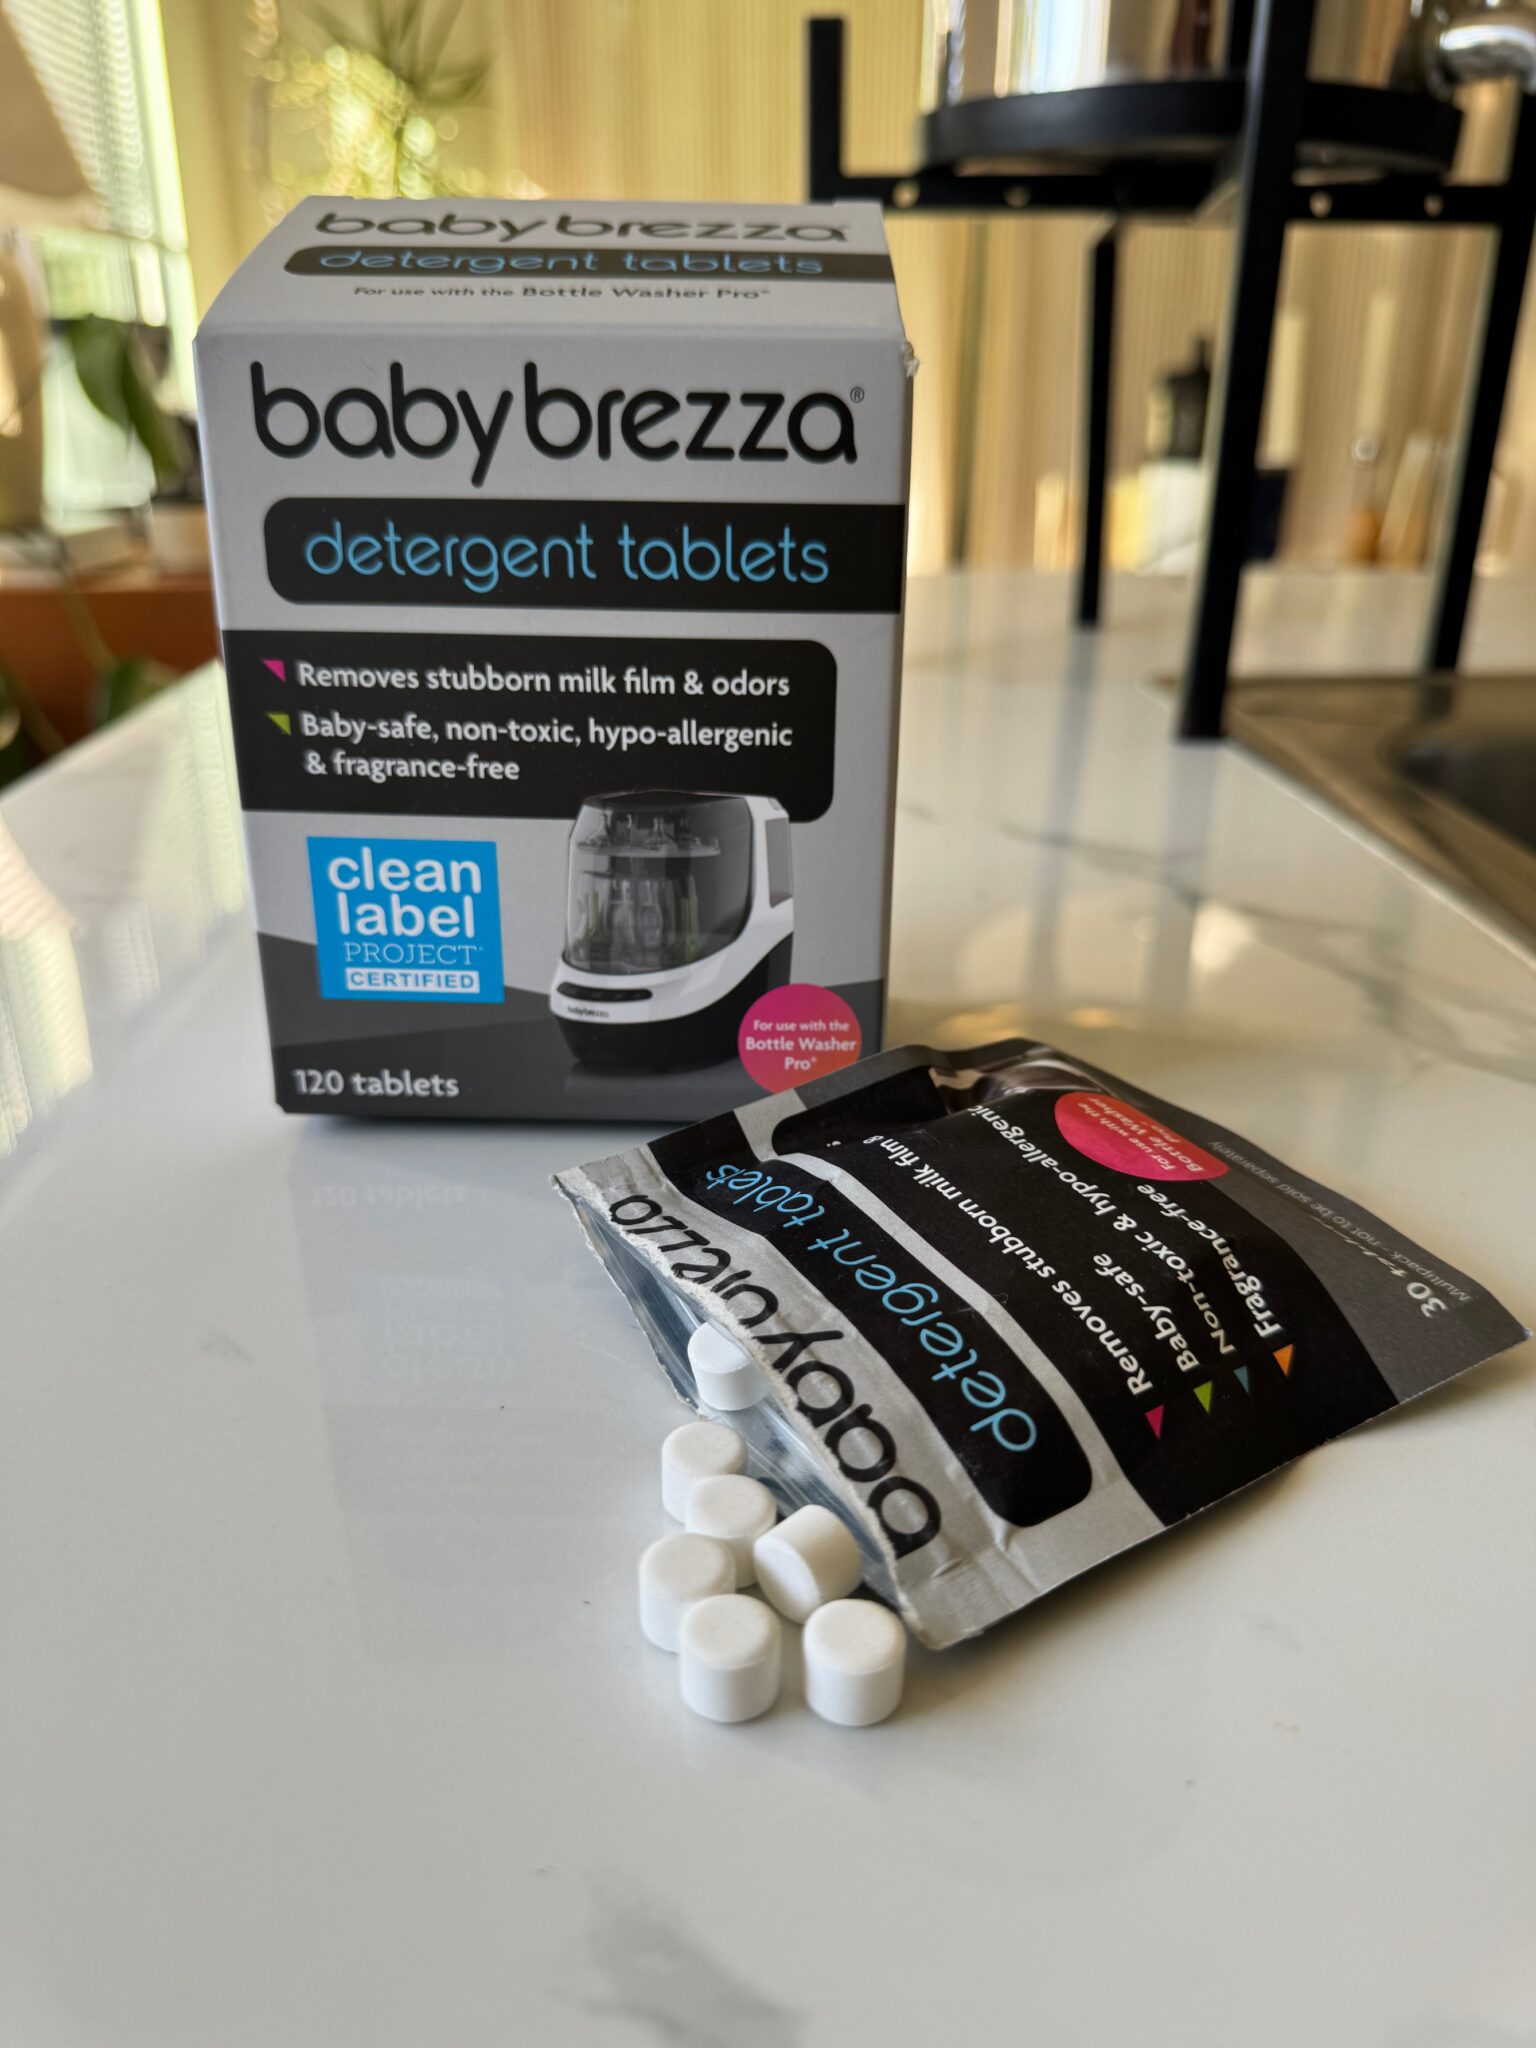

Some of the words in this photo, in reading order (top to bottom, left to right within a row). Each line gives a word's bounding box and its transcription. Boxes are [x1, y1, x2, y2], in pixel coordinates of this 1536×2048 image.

[319, 249, 598, 274] detergent
[623, 252, 823, 274] tablets
[354, 287, 384, 296] For
[392, 288, 424, 296] use
[431, 286, 474, 297] with
[481, 287, 514, 297] the
[522, 286, 602, 298] Bottle
[612, 287, 709, 299] Washer
[305, 519, 597, 593] detergent
[617, 523, 830, 584] tablets
[297, 660, 420, 690] Removes
[425, 662, 552, 692] stubborn
[558, 665, 617, 694] milk
[623, 666, 676, 695] film
[683, 669, 704, 695] &
[712, 668, 790, 696] odors
[300, 710, 440, 745] Baby-safe,
[446, 717, 582, 747] non-toxic,
[588, 716, 793, 754] hypo-allergenic
[304, 750, 327, 776] &
[332, 749, 521, 784] fragrance-free
[327, 846, 482, 894] clean
[336, 891, 475, 939] label
[350, 971, 475, 989] CERTIFIED
[753, 1019, 773, 1032] For
[776, 1021, 796, 1032] use
[799, 1019, 826, 1032] with
[829, 1019, 850, 1032] the
[745, 1036, 794, 1051] Bottle
[798, 1036, 857, 1052] Washer
[293, 1068, 345, 1096] 120
[350, 1068, 460, 1098] tablets
[1078, 1102, 1101, 1118] the
[1087, 1096, 1148, 1136] Washer
[1100, 1117, 1129, 1137] with
[880, 1138, 920, 1167] film
[968, 1104, 1117, 1216] hypo-allergenic
[1128, 1137, 1154, 1154] use
[1149, 1136, 1205, 1173] Bottle
[1150, 1154, 1178, 1171] For
[1208, 1140, 1280, 1184] separately
[705, 1164, 825, 1230] tablets
[913, 1163, 962, 1201] milk
[1277, 1184, 1312, 1203] sold
[1113, 1213, 1138, 1231] &
[1309, 1202, 1334, 1217] be
[1332, 1215, 1351, 1229] to
[958, 1198, 1056, 1278] stubborn
[1351, 1226, 1382, 1247] not
[1137, 1184, 1284, 1339] Fragrance-free
[1391, 1250, 1472, 1302] Multipack
[1135, 1231, 1236, 1356] Non-toxic
[1406, 1281, 1450, 1318] 30
[1093, 1253, 1201, 1372] Baby-safe
[806, 1227, 1037, 1452] detergent
[1052, 1280, 1153, 1395] Removes
